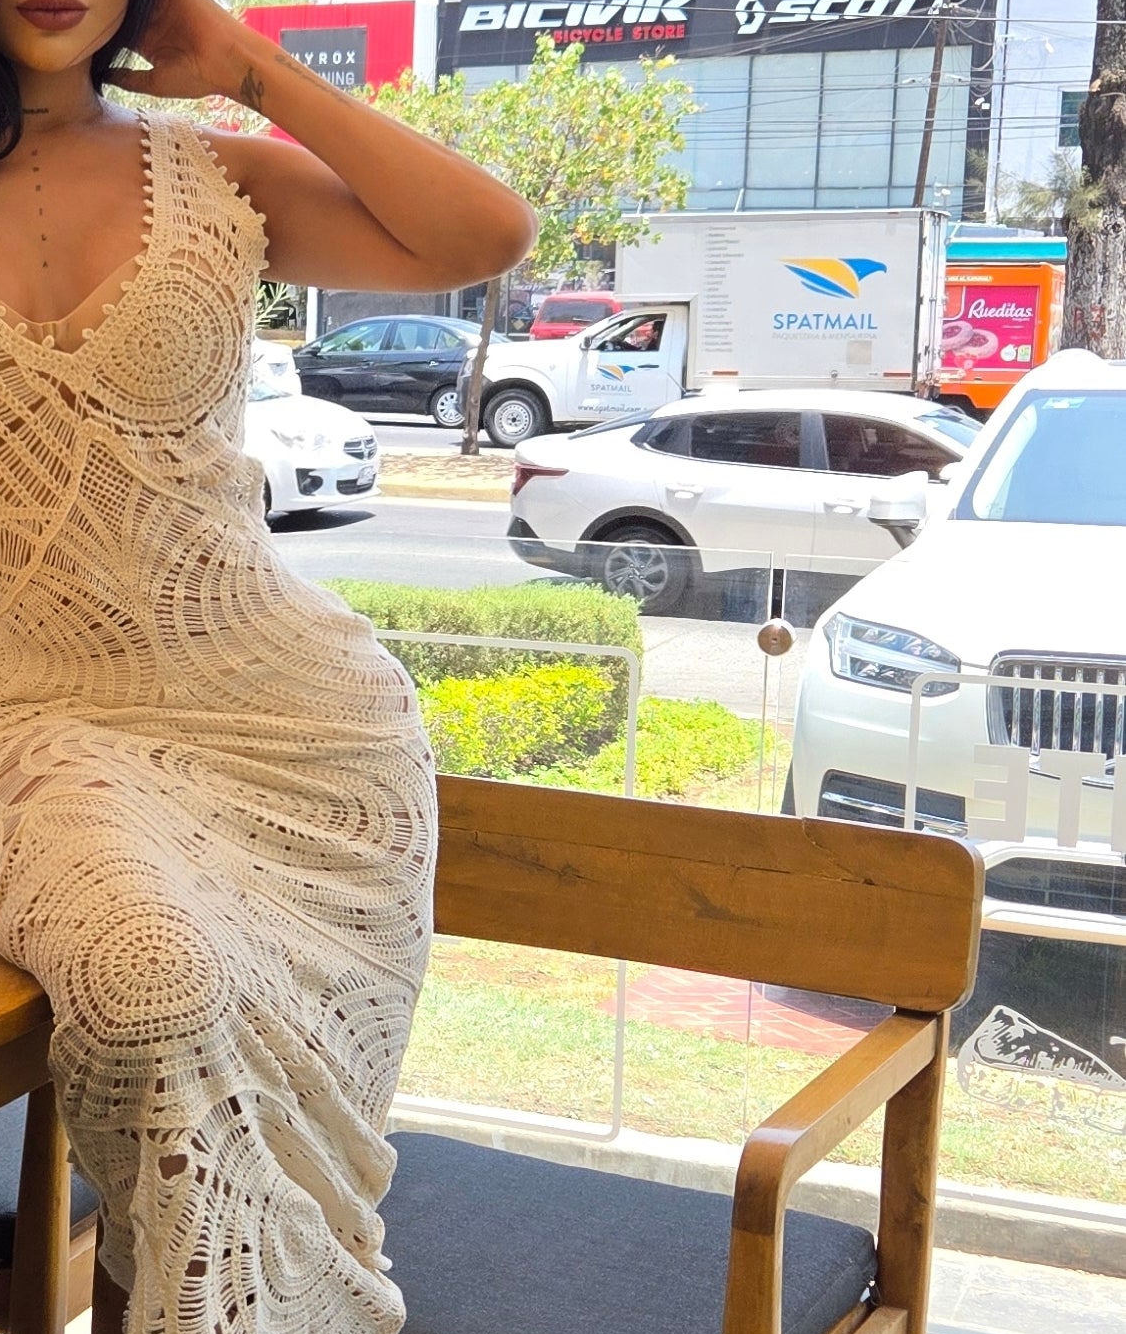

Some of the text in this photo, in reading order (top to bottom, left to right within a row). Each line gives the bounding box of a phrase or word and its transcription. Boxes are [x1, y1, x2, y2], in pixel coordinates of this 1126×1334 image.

[553, 24, 686, 44] BICYCLE STORE
[967, 298, 1034, 319] Rueditas
[773, 313, 878, 330] SPATMAIL
[590, 384, 632, 393] SPATMAIL
